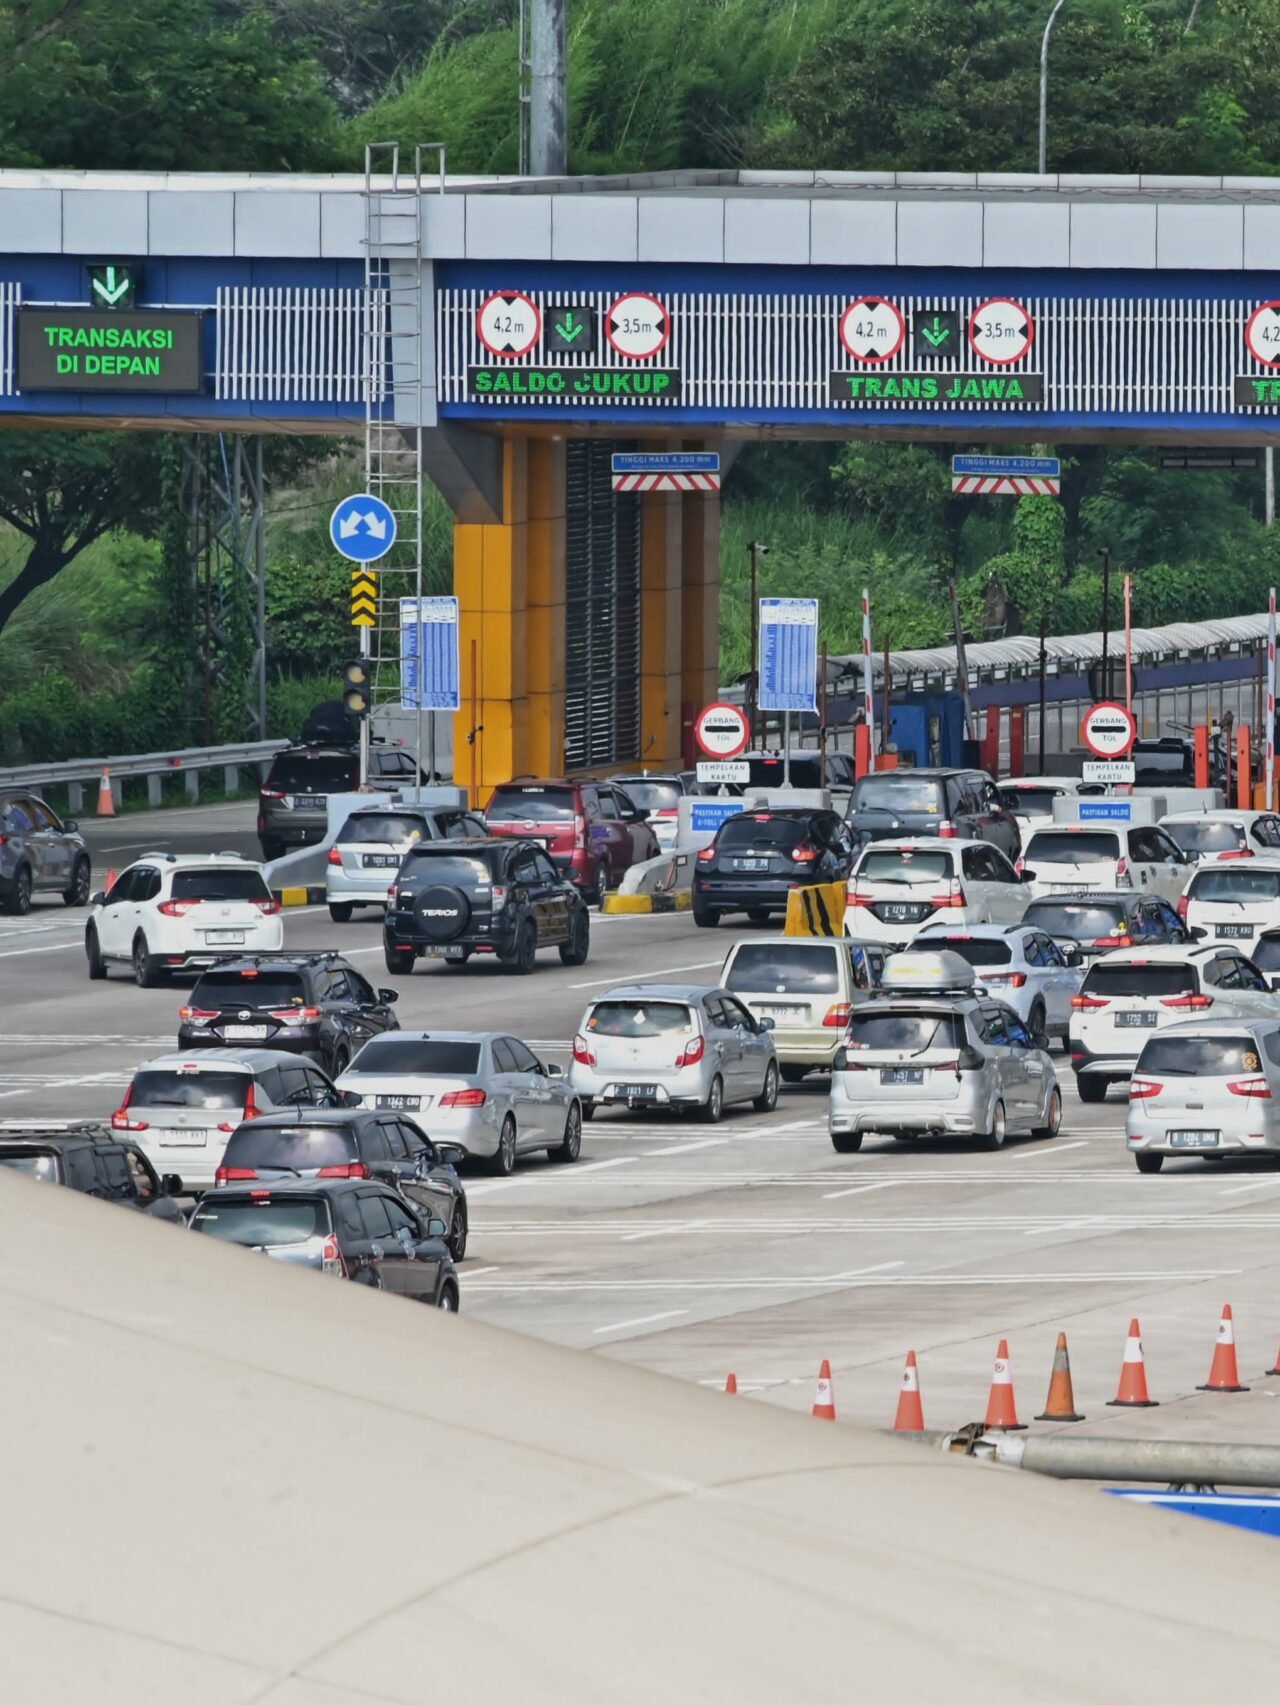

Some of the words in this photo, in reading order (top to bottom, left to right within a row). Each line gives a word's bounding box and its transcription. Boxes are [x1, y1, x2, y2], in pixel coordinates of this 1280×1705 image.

[494, 316, 512, 333] 4,2
[855, 321, 874, 338] 4,2
[44, 327, 174, 349] TRANSAKSI
[1262, 326, 1280, 343] 4,2
[56, 354, 79, 375] DI
[84, 355, 161, 376] DEPAN
[475, 371, 566, 393] SALDO
[573, 372, 670, 394] CUKUP
[847, 376, 939, 399] TRANS
[946, 377, 1025, 399] JAWA
[1090, 717, 1128, 725] GERBANG
[421, 908, 459, 917] TERIOS
